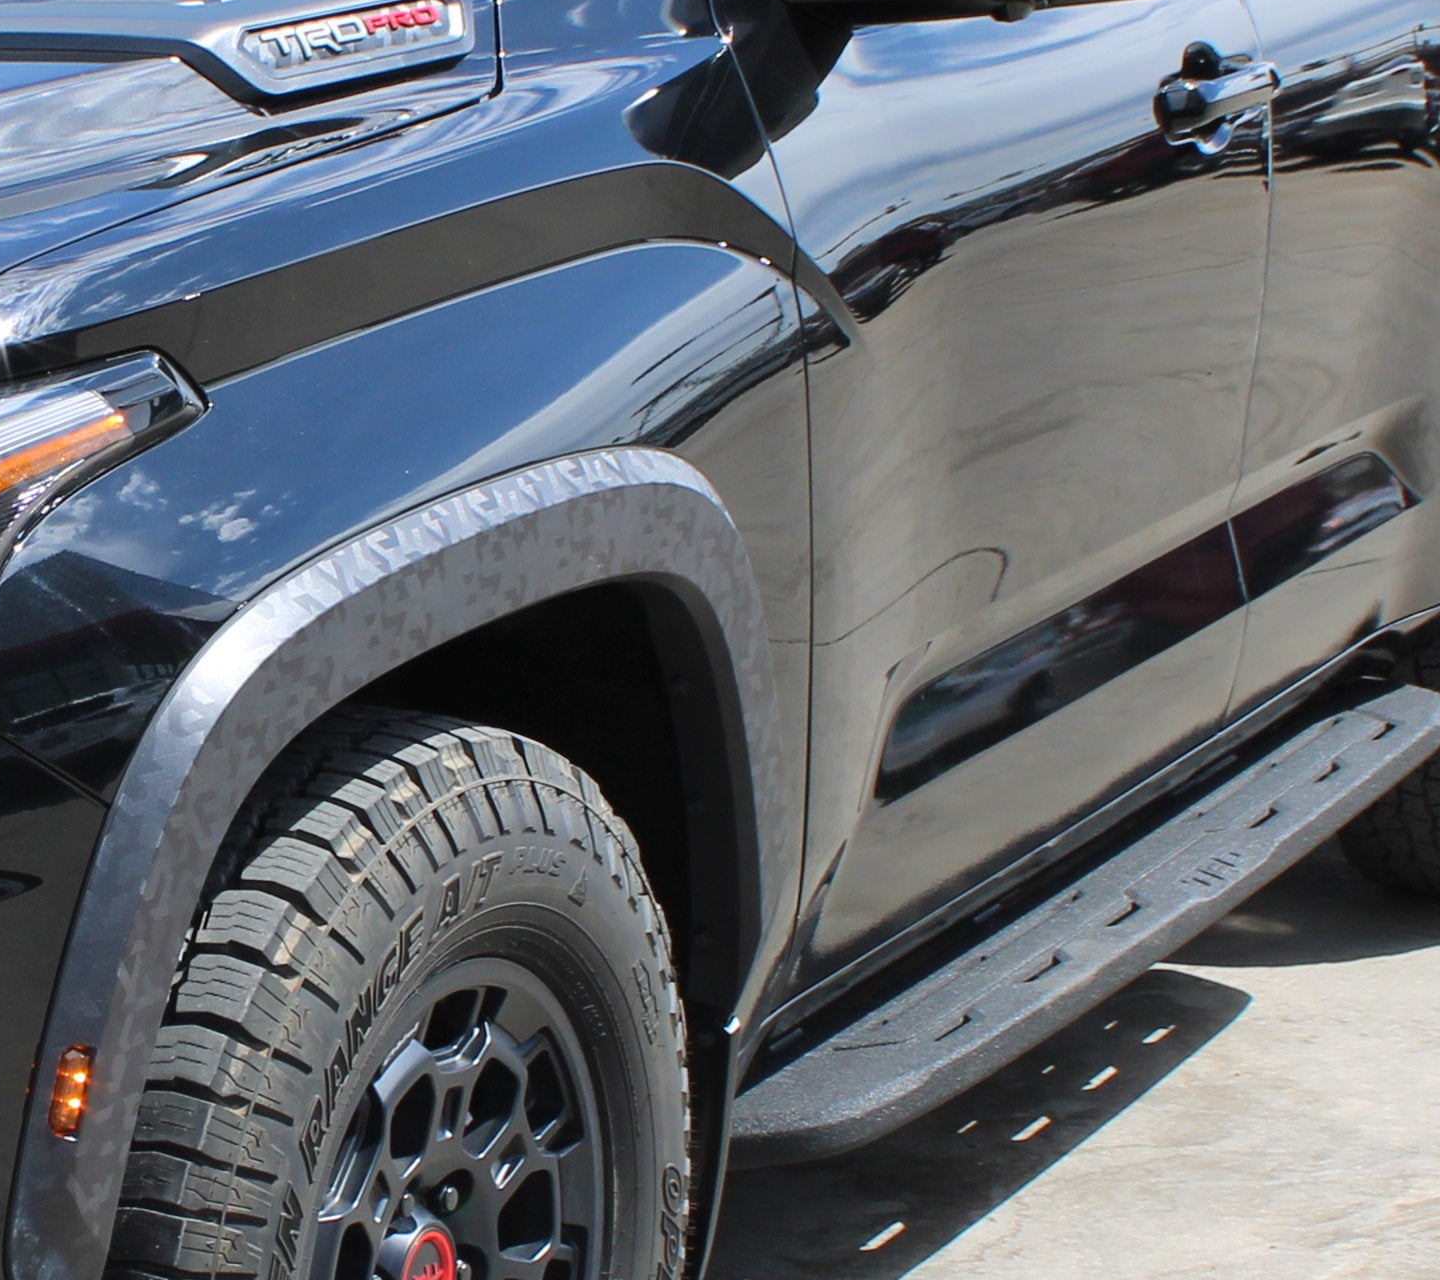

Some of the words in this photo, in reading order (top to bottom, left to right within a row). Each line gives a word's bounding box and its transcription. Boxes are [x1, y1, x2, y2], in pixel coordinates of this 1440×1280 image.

[260, 17, 367, 60] TRD
[364, 4, 441, 36] PRO
[299, 906, 425, 1185] RANGE
[424, 851, 505, 940] A/T
[506, 845, 568, 878] PLUS
